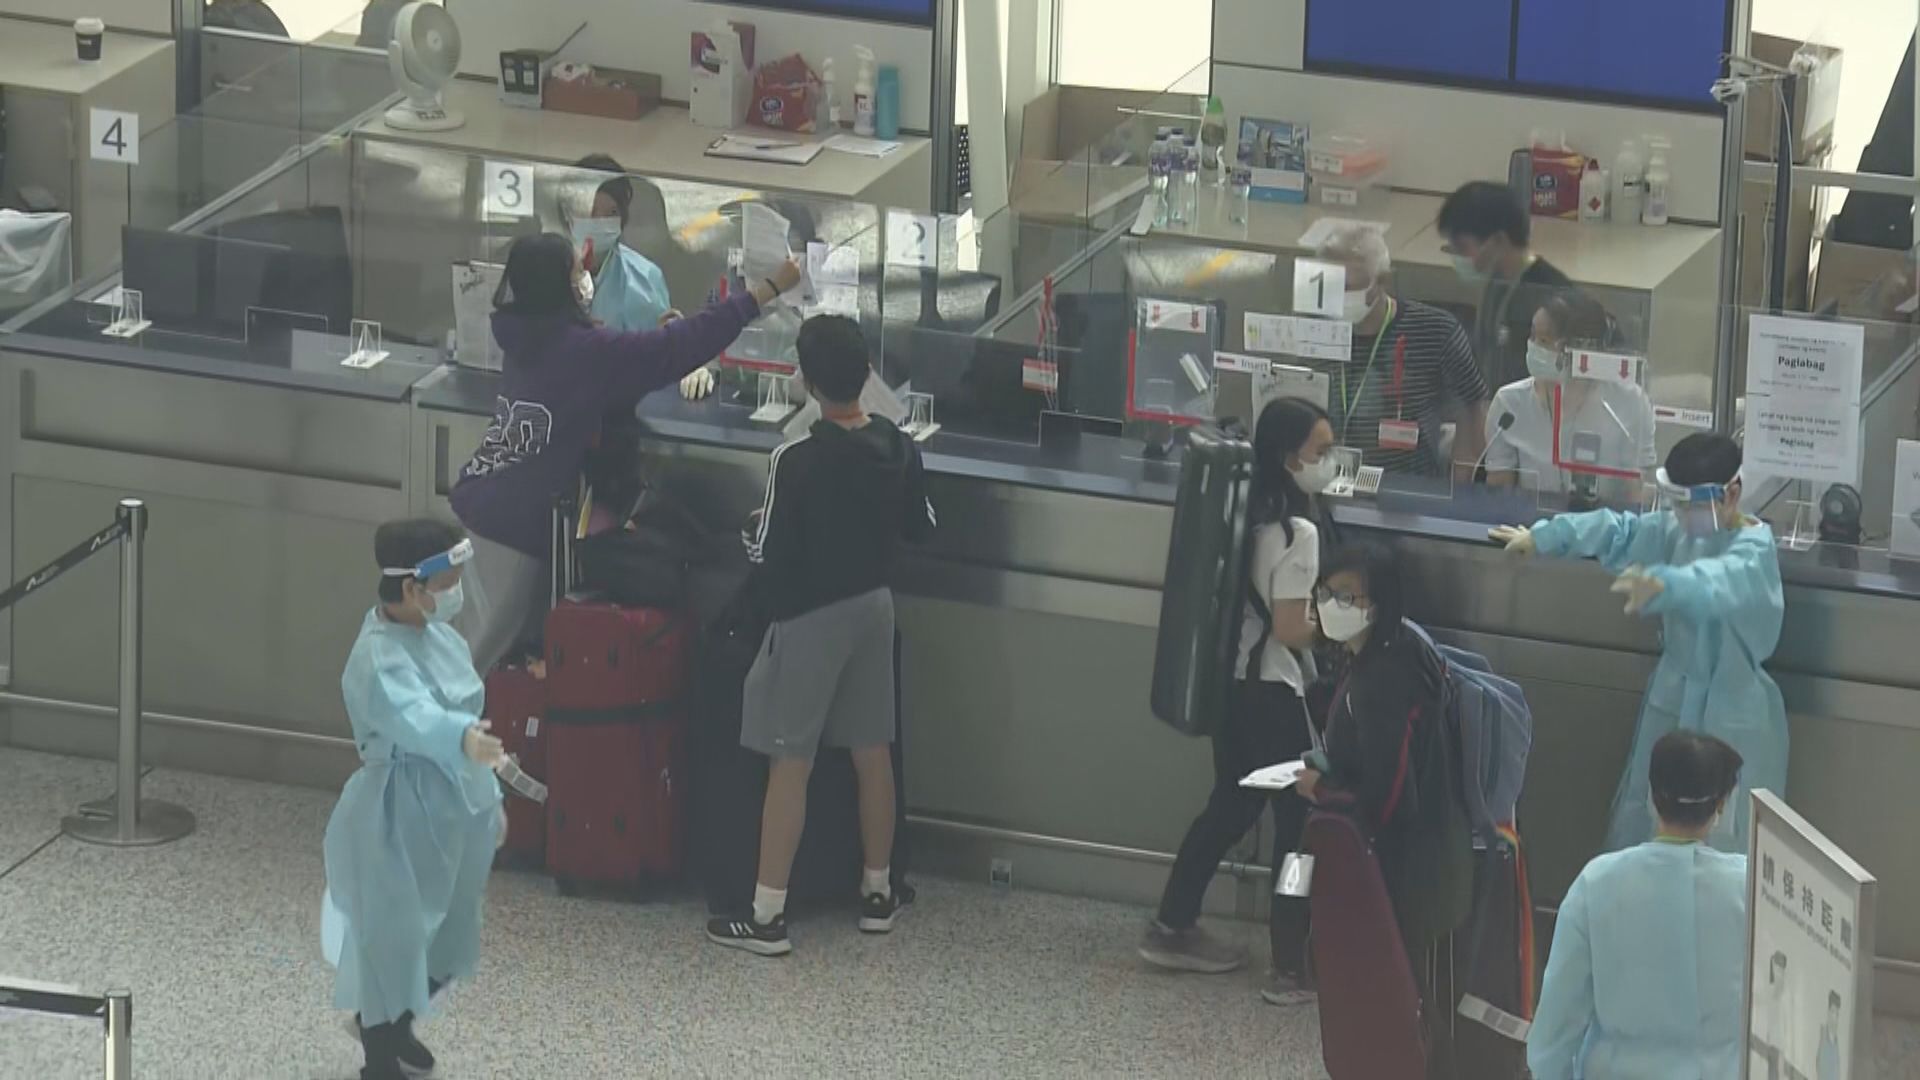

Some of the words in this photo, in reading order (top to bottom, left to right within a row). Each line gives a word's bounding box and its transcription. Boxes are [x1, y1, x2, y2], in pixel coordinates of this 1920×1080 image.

[101, 115, 127, 157] 4
[498, 168, 522, 208] 3
[901, 221, 926, 262] 2
[1308, 269, 1325, 310] 1
[1241, 358, 1269, 372] Insert
[1778, 355, 1825, 371] Paglabag
[1681, 408, 1710, 423] Insert
